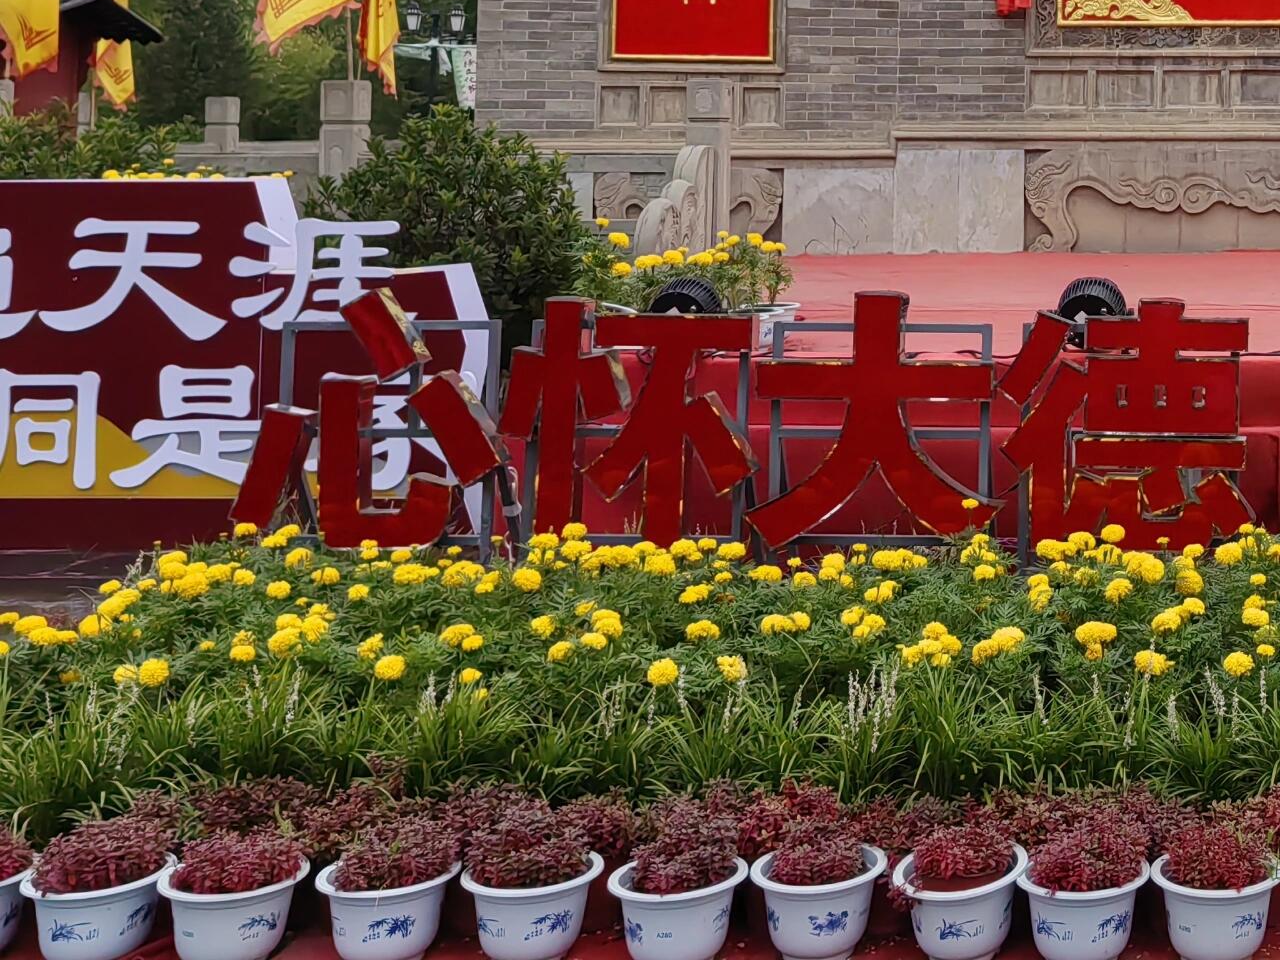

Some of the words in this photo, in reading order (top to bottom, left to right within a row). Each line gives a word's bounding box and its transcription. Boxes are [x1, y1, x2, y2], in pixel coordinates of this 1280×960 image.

[0, 217, 417, 341] 天涯
[228, 287, 1257, 551] 心怀大德
